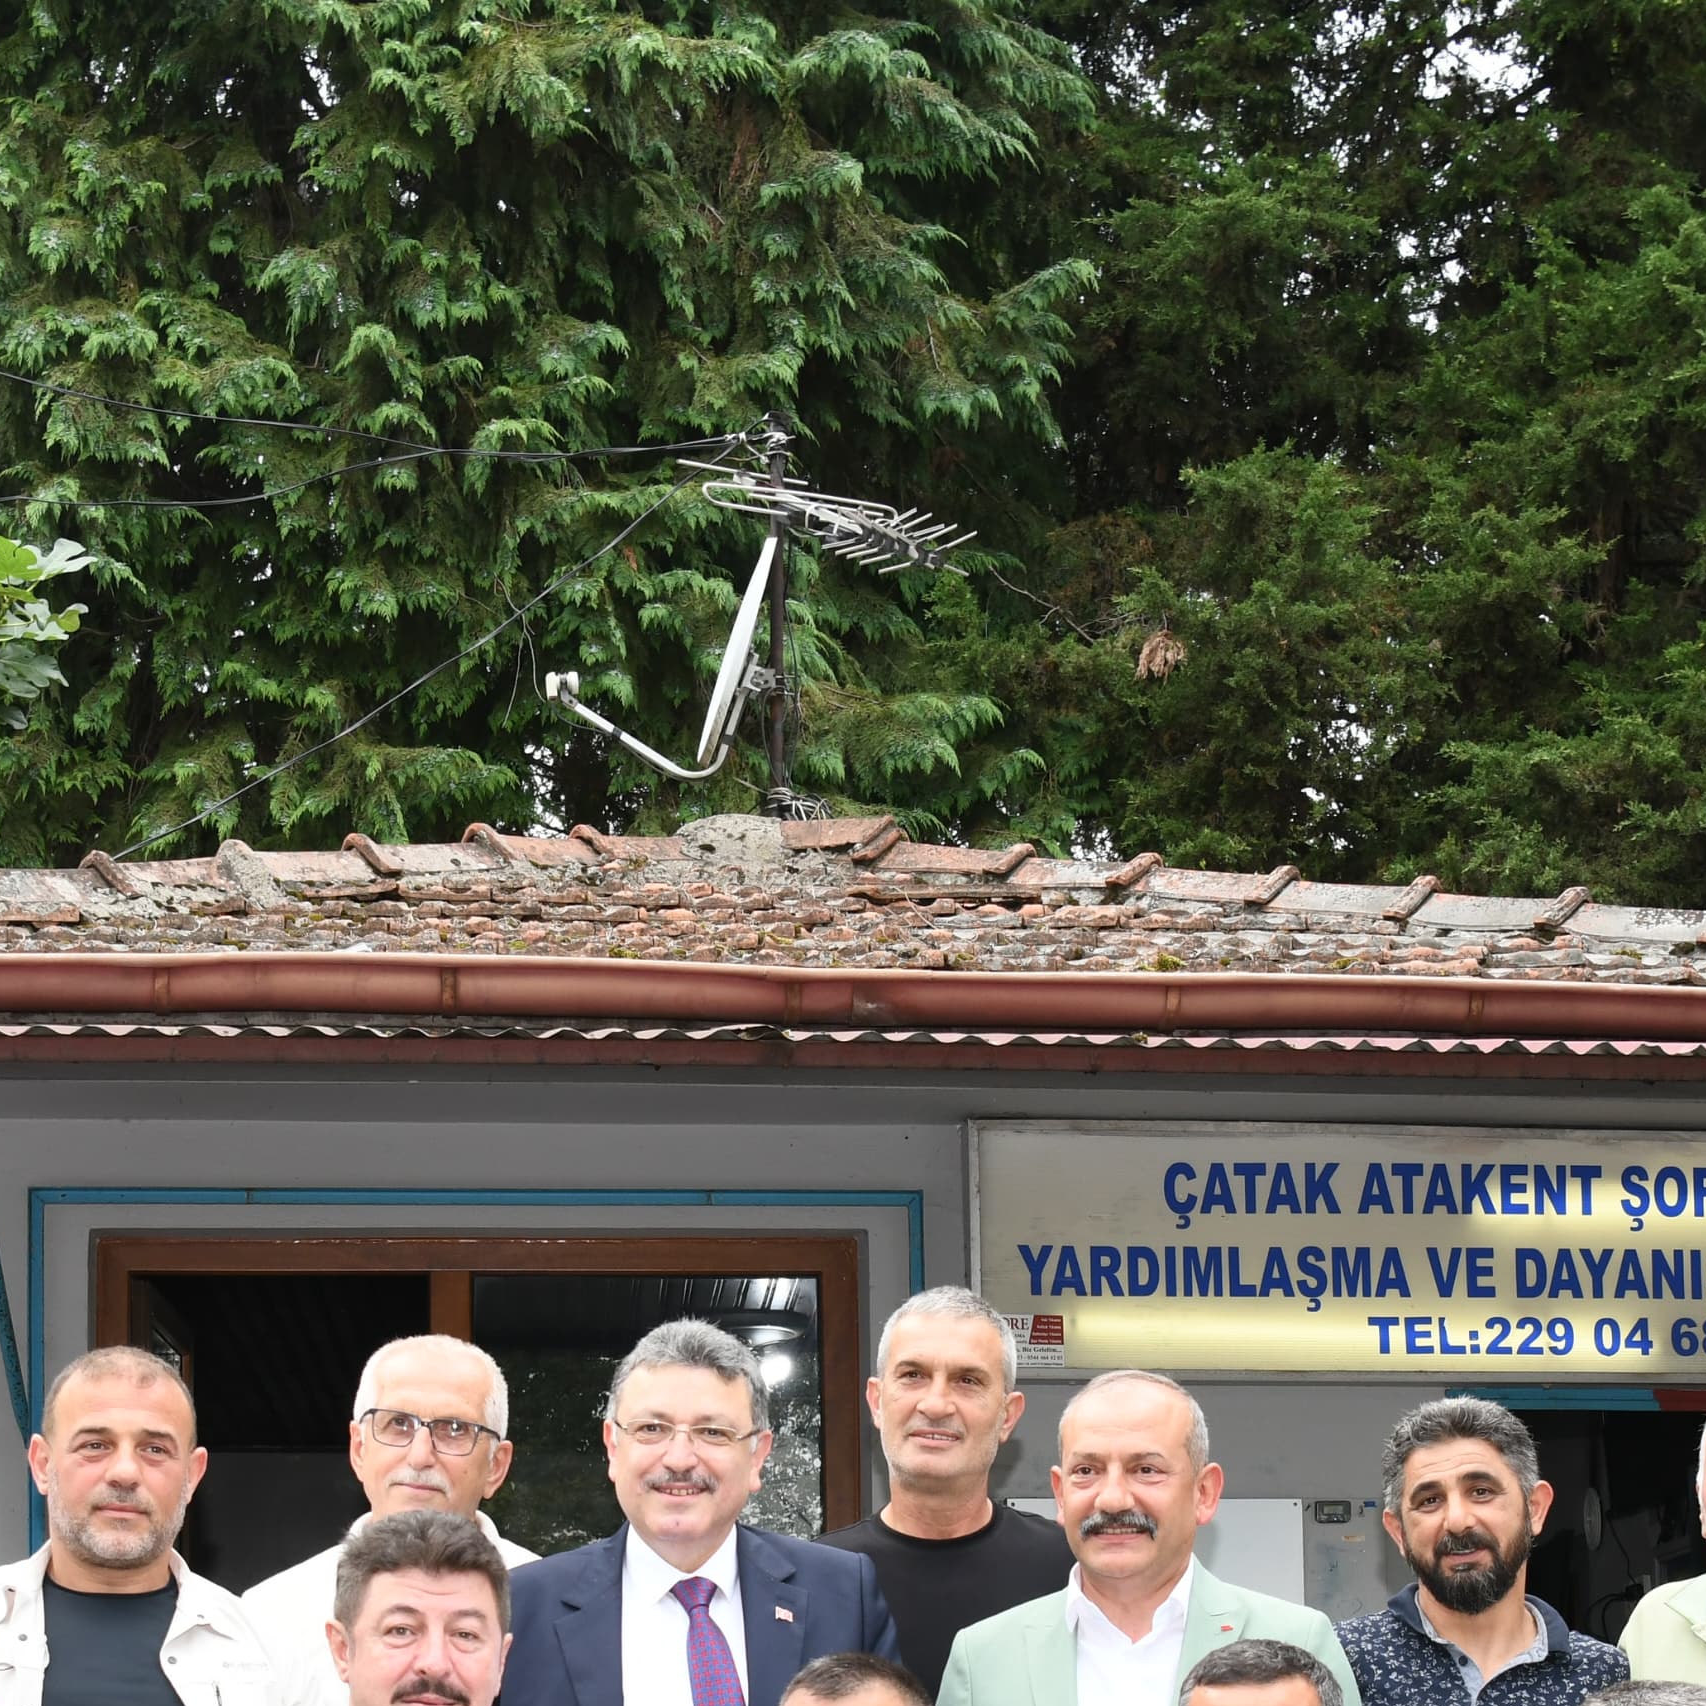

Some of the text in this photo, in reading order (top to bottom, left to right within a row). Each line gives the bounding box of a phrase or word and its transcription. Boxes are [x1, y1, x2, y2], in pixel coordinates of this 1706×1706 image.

[1163, 1161, 1342, 1230] ÇATAK
[1358, 1163, 1602, 1216] ATAKENT
[1018, 1245, 1411, 1312] YARDIMLAŞMA
[1427, 1247, 1496, 1298] VE
[1368, 1316, 1575, 1356] TEL:229
[1593, 1317, 1653, 1357] 04
